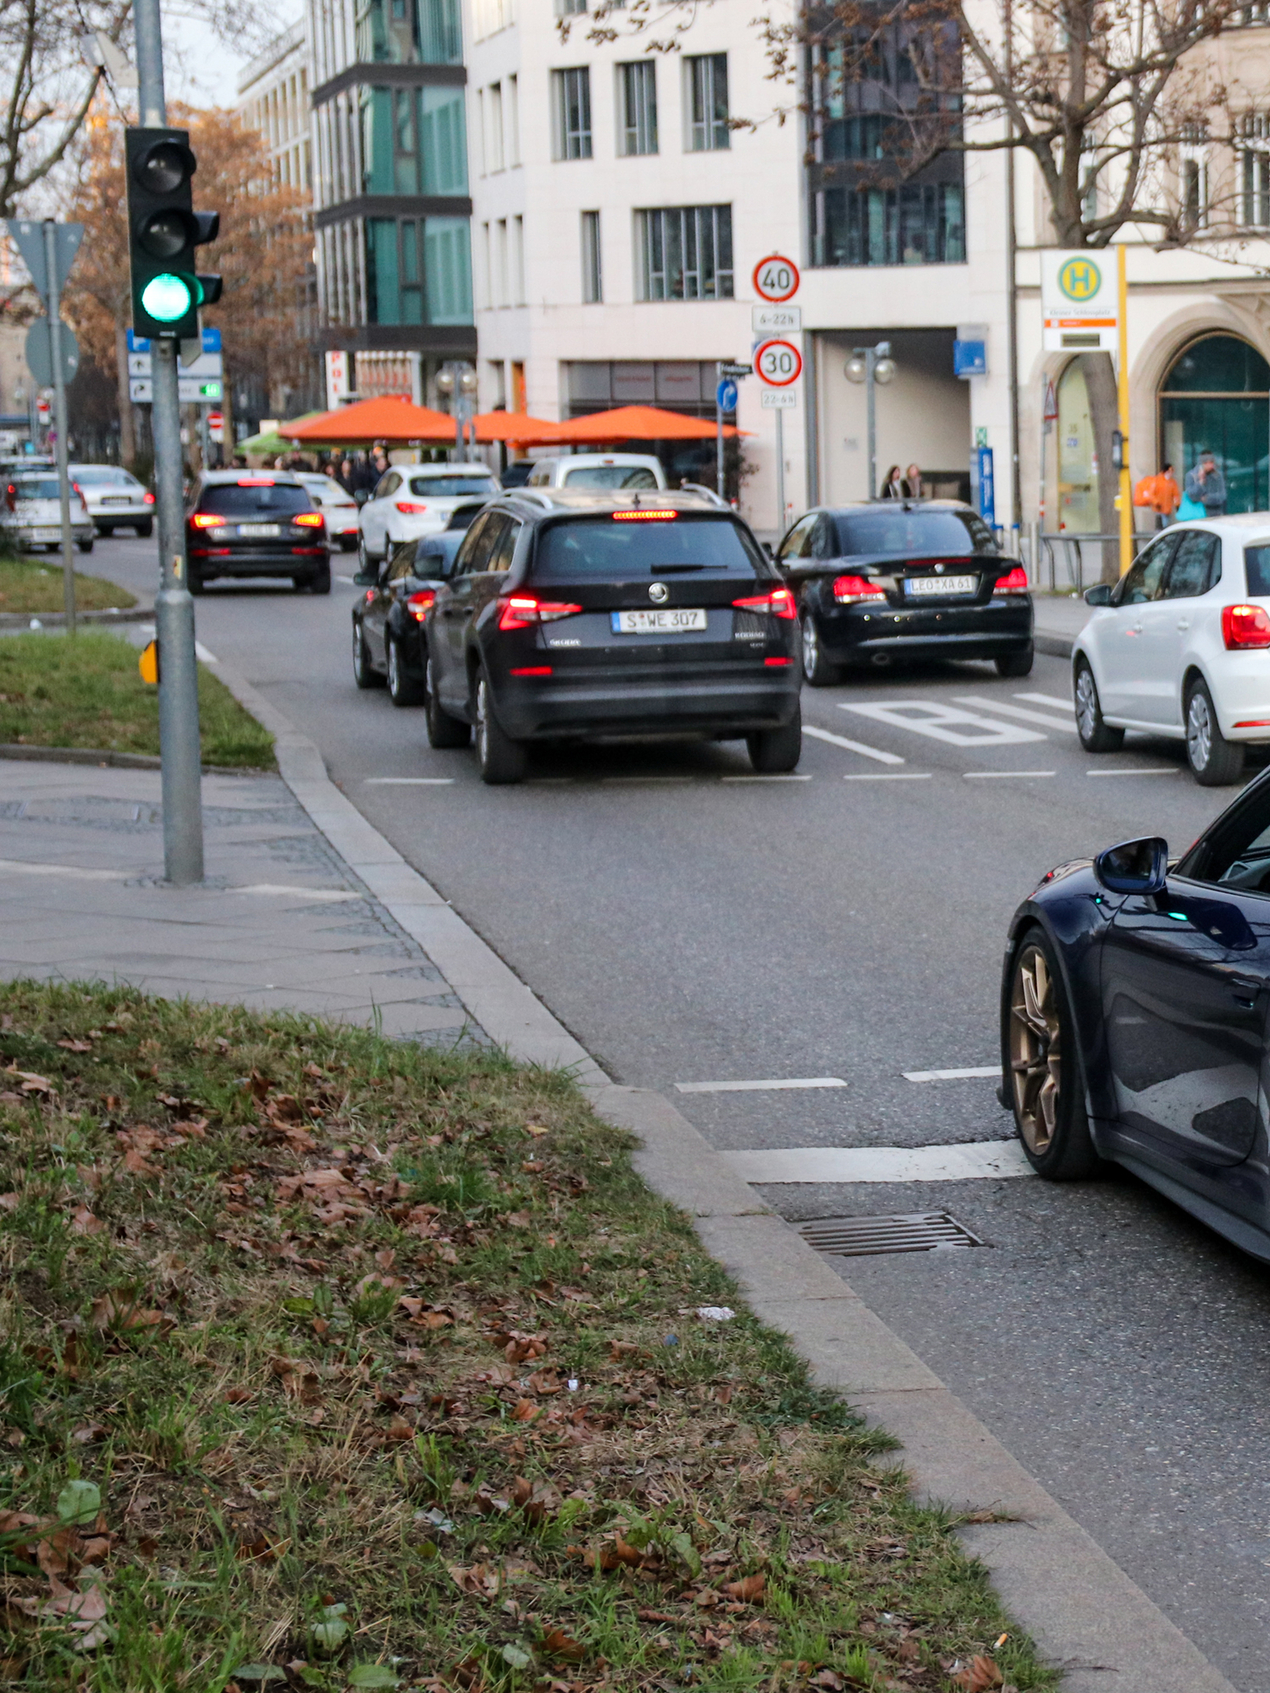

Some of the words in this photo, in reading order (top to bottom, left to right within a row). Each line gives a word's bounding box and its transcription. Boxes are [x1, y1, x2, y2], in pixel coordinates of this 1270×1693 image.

[762, 268, 790, 290] 40
[1070, 267, 1090, 291] H
[765, 353, 792, 374] 30
[911, 580, 934, 591] LEO
[941, 578, 955, 589] XA
[957, 577, 971, 588] 61
[627, 613, 637, 628] S
[648, 612, 667, 627] WE
[671, 611, 698, 626] 307
